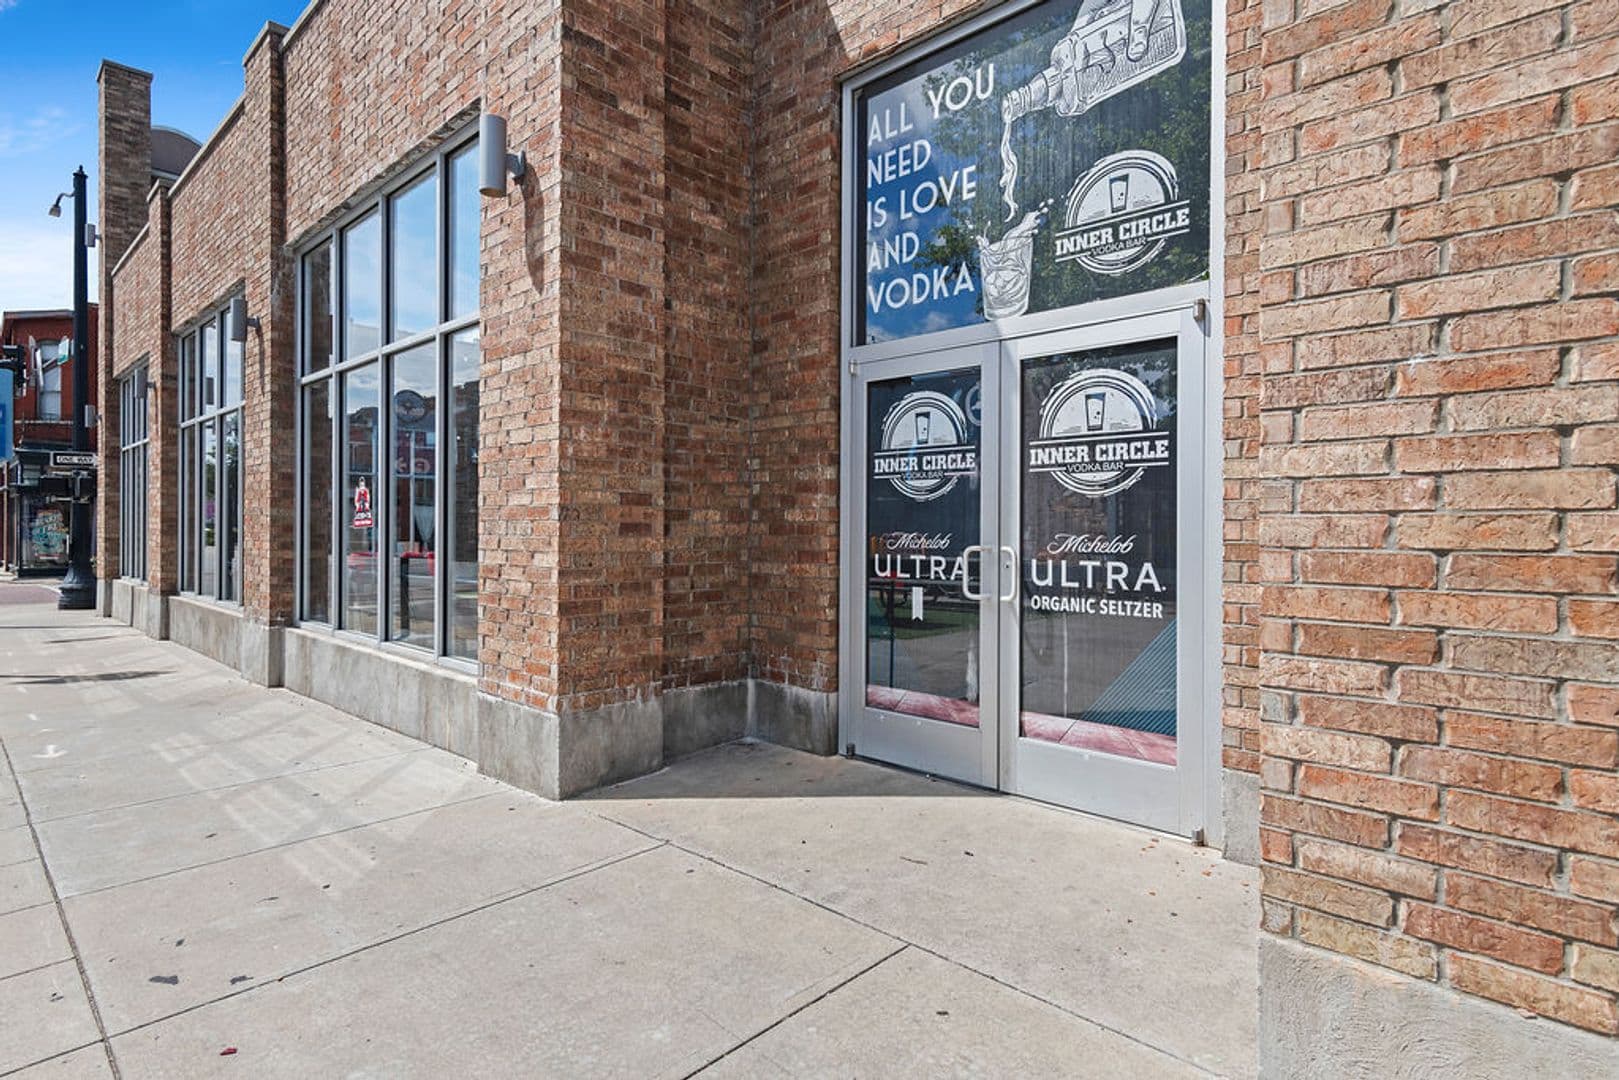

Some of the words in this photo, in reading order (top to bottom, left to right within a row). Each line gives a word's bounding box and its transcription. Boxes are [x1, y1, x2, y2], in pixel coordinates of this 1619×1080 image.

[868, 102, 913, 146] ALL
[928, 63, 994, 119] YOU
[867, 139, 931, 189] NEED
[867, 196, 887, 231] IS
[900, 165, 976, 220] LOVE
[1055, 227, 1114, 256] INNER
[1119, 207, 1191, 240] CIRCLE
[867, 232, 920, 272] AND
[1091, 242, 1125, 256] VODKA
[1126, 237, 1147, 249] BAR
[867, 261, 975, 314] VODKA
[874, 457, 918, 473] INNER
[922, 453, 976, 471] CIRCLE
[1029, 445, 1090, 466] INNER
[1095, 439, 1169, 462] CIRCLE
[928, 471, 944, 479] BAR
[1067, 463, 1101, 473] VODKA
[1103, 461, 1125, 471] BAR
[886, 532, 953, 550] Michelob
[1046, 533, 1137, 555] Michelob
[874, 554, 966, 580] ULTRA
[1030, 595, 1096, 614] ORGANIC
[1100, 598, 1163, 619] SELTZER
